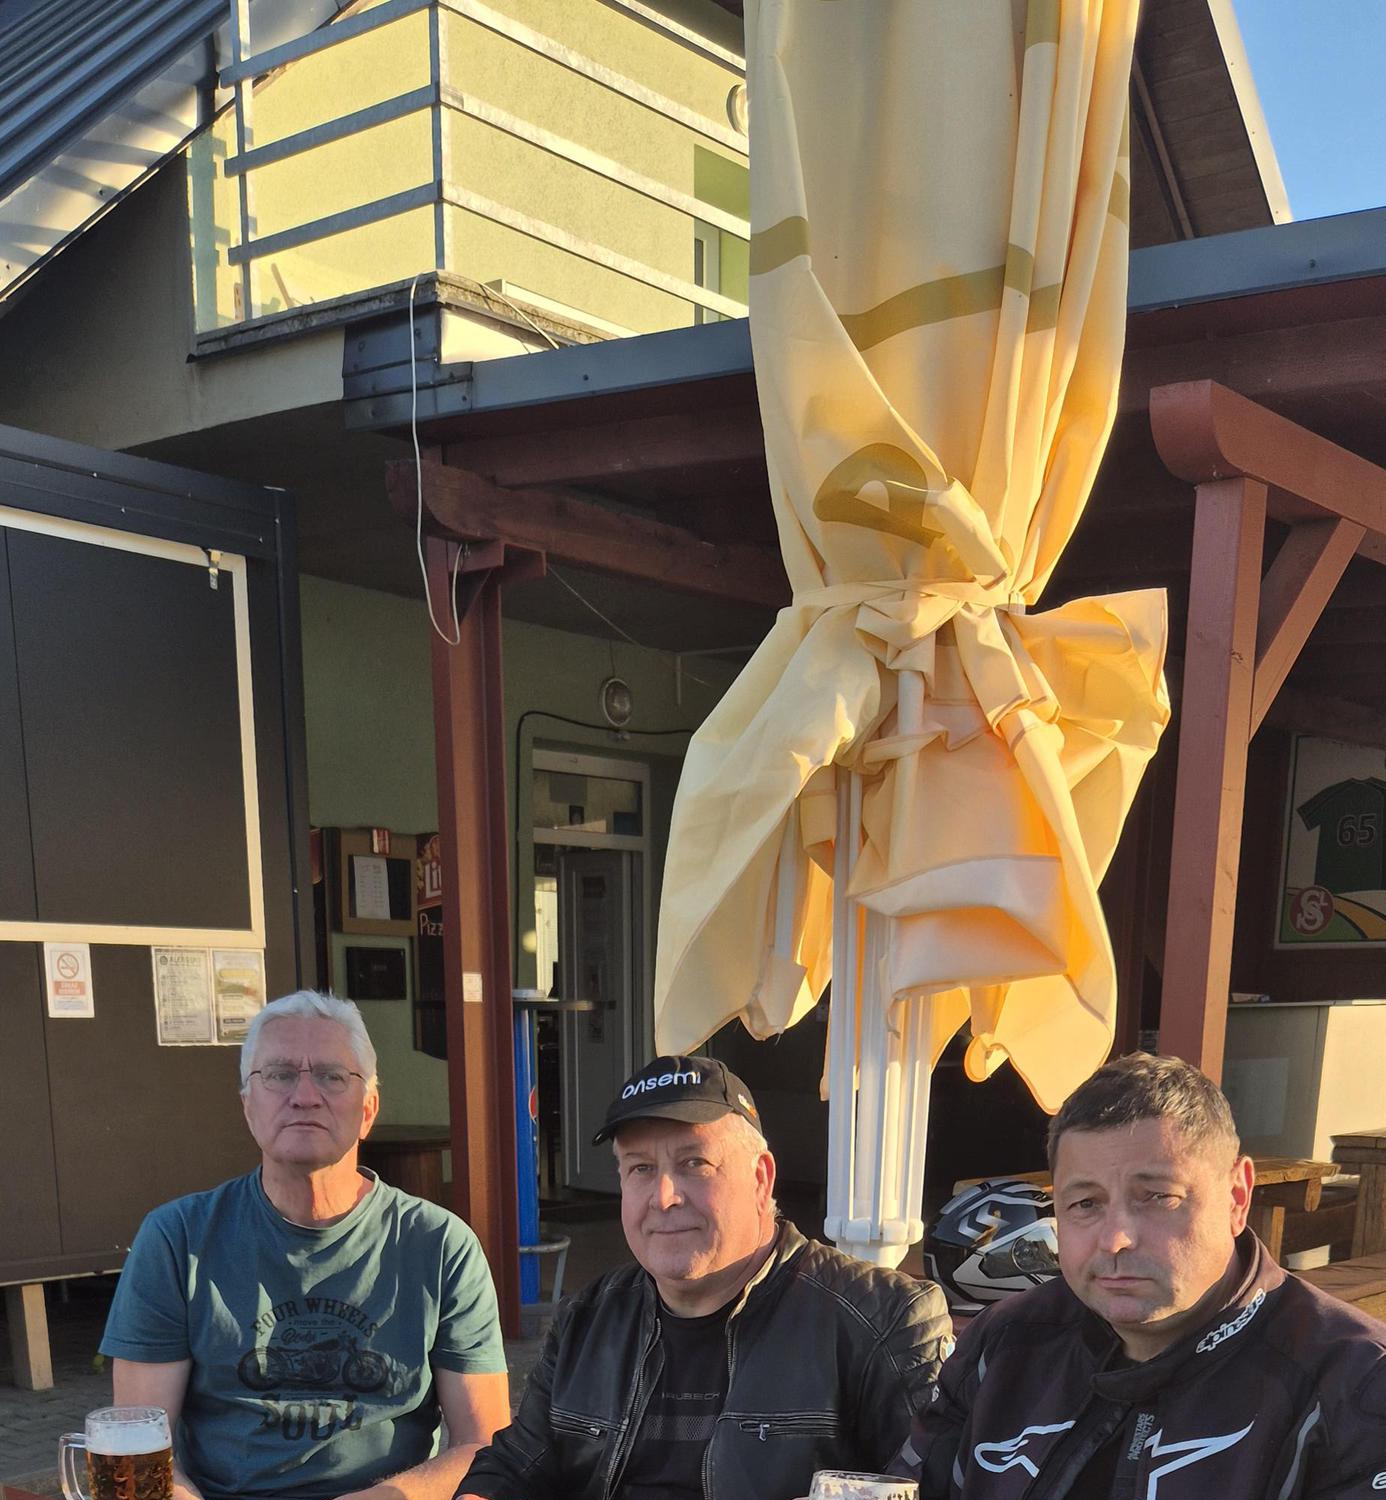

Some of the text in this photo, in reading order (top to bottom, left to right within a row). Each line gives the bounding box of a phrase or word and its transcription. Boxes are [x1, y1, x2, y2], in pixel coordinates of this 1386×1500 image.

[1336, 813, 1377, 848] 65
[425, 861, 442, 897] Li
[621, 1070, 701, 1100] onsemi
[251, 1297, 379, 1338] FOUR WHEELS
[259, 1392, 365, 1441] SOUL
